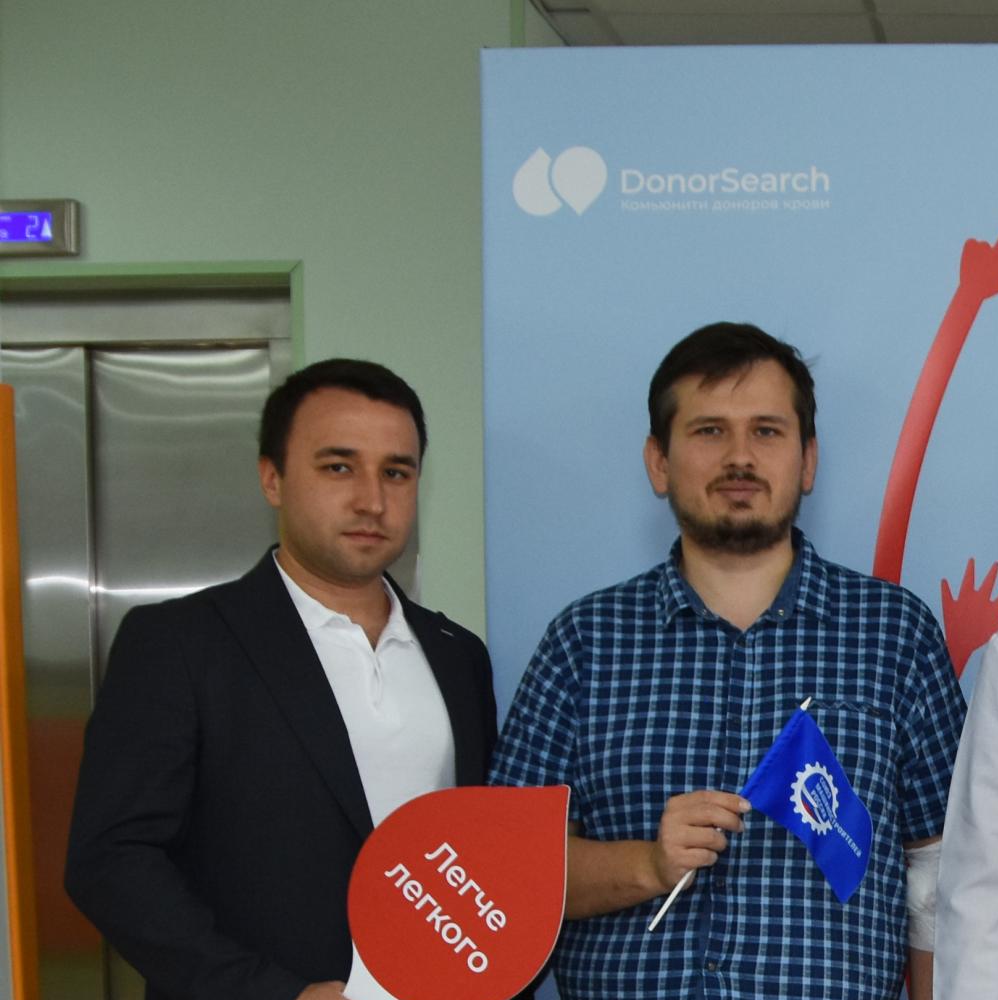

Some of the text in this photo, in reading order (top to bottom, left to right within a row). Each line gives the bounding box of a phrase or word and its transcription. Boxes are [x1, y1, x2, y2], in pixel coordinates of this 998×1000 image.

[620, 166, 830, 195] DonorSearch
[384, 863, 489, 973] легкого
[424, 842, 507, 931] Легче
